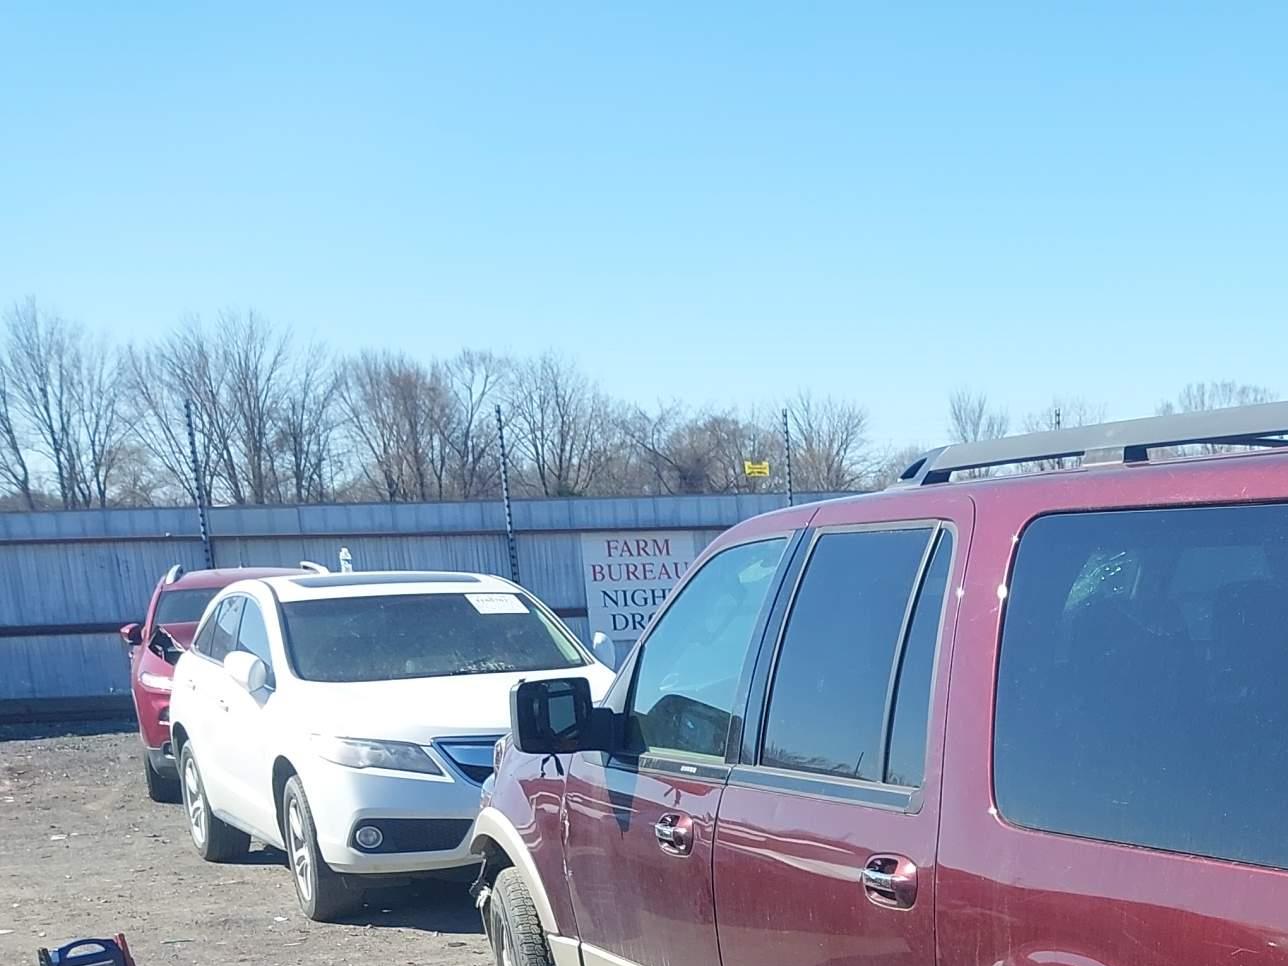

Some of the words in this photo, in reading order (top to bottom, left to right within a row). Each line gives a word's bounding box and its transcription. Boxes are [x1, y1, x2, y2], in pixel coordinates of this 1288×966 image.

[606, 539, 671, 558] FARM
[591, 562, 689, 582] BUREAU
[601, 588, 672, 609] NIGH
[611, 612, 654, 632] DR
